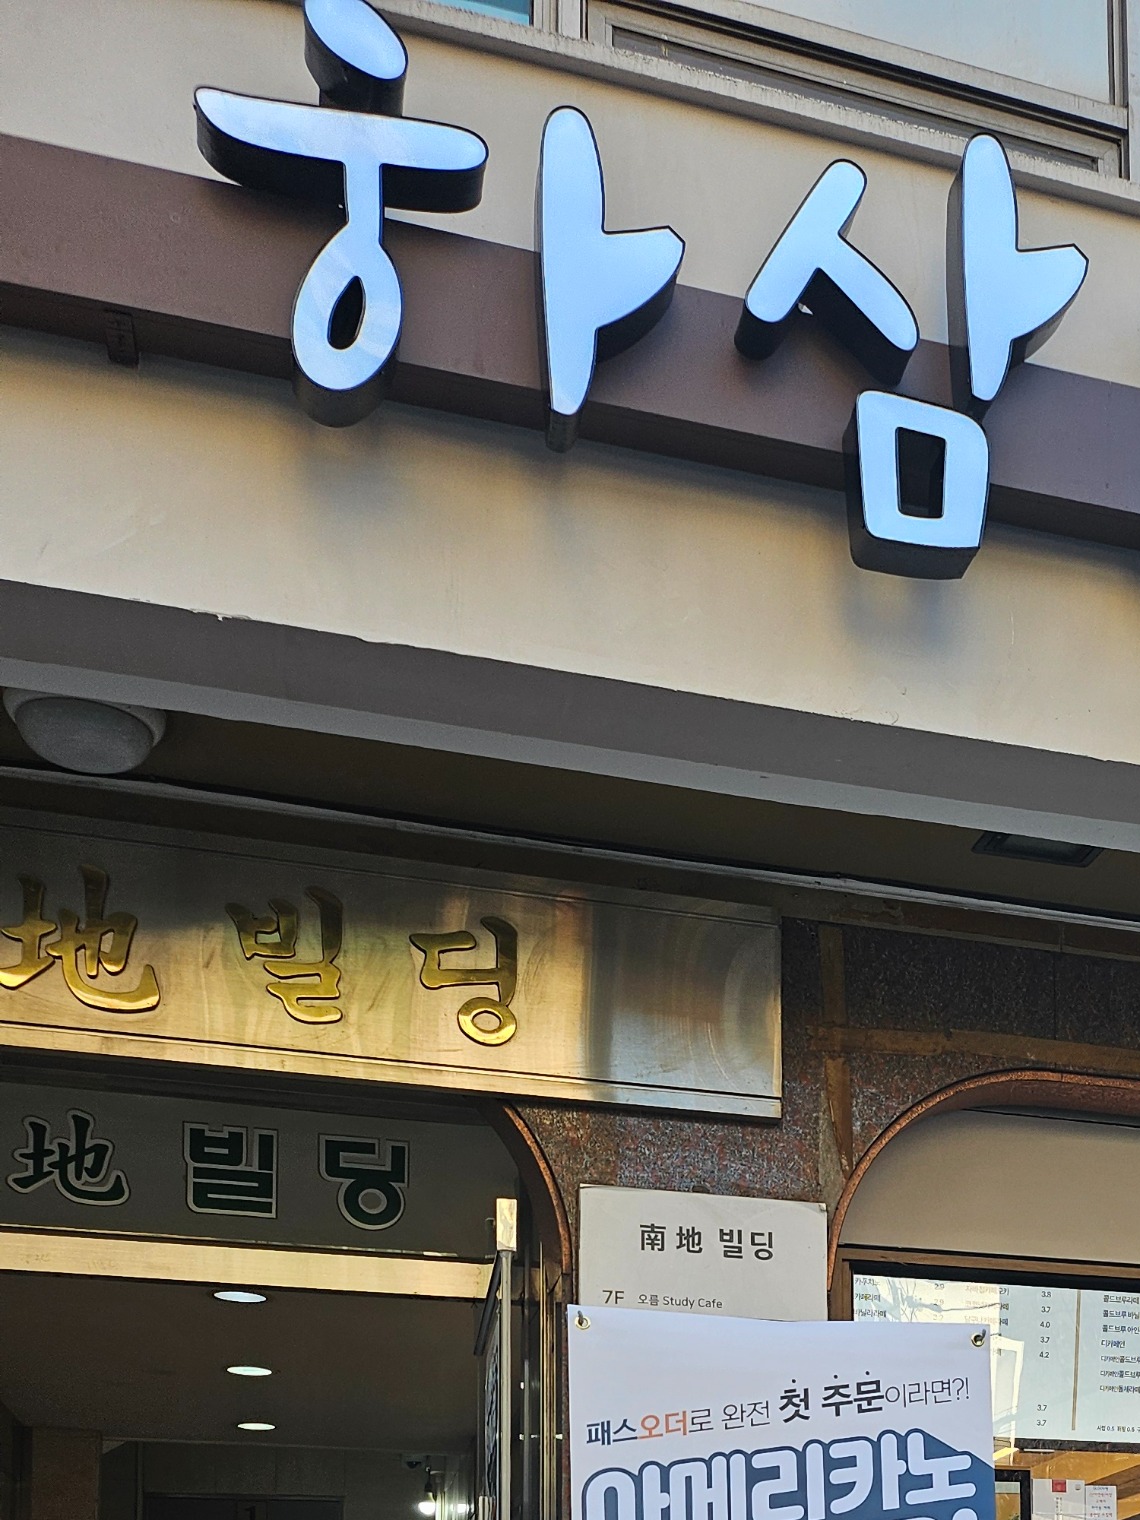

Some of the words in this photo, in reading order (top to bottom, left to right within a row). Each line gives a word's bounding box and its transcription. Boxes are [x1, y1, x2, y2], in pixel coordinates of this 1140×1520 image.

[718, 1226, 776, 1262] 빌딩
[1041, 1290, 1052, 1298] 3.8
[602, 1290, 625, 1305] 7F
[663, 1294, 695, 1311] Study
[697, 1296, 723, 1309] Cafe
[1041, 1306, 1051, 1314] 3.7
[1039, 1321, 1051, 1329] 4.0
[1040, 1336, 1050, 1344] 3.7
[1039, 1351, 1050, 1359] 4.2
[586, 1408, 714, 1446] 패스오더로
[721, 1401, 771, 1431] 완전
[779, 1381, 811, 1423] 첫
[821, 1375, 971, 1418] 주문이라면?!
[1037, 1404, 1047, 1412] 3.7
[1036, 1419, 1047, 1427] 3.7
